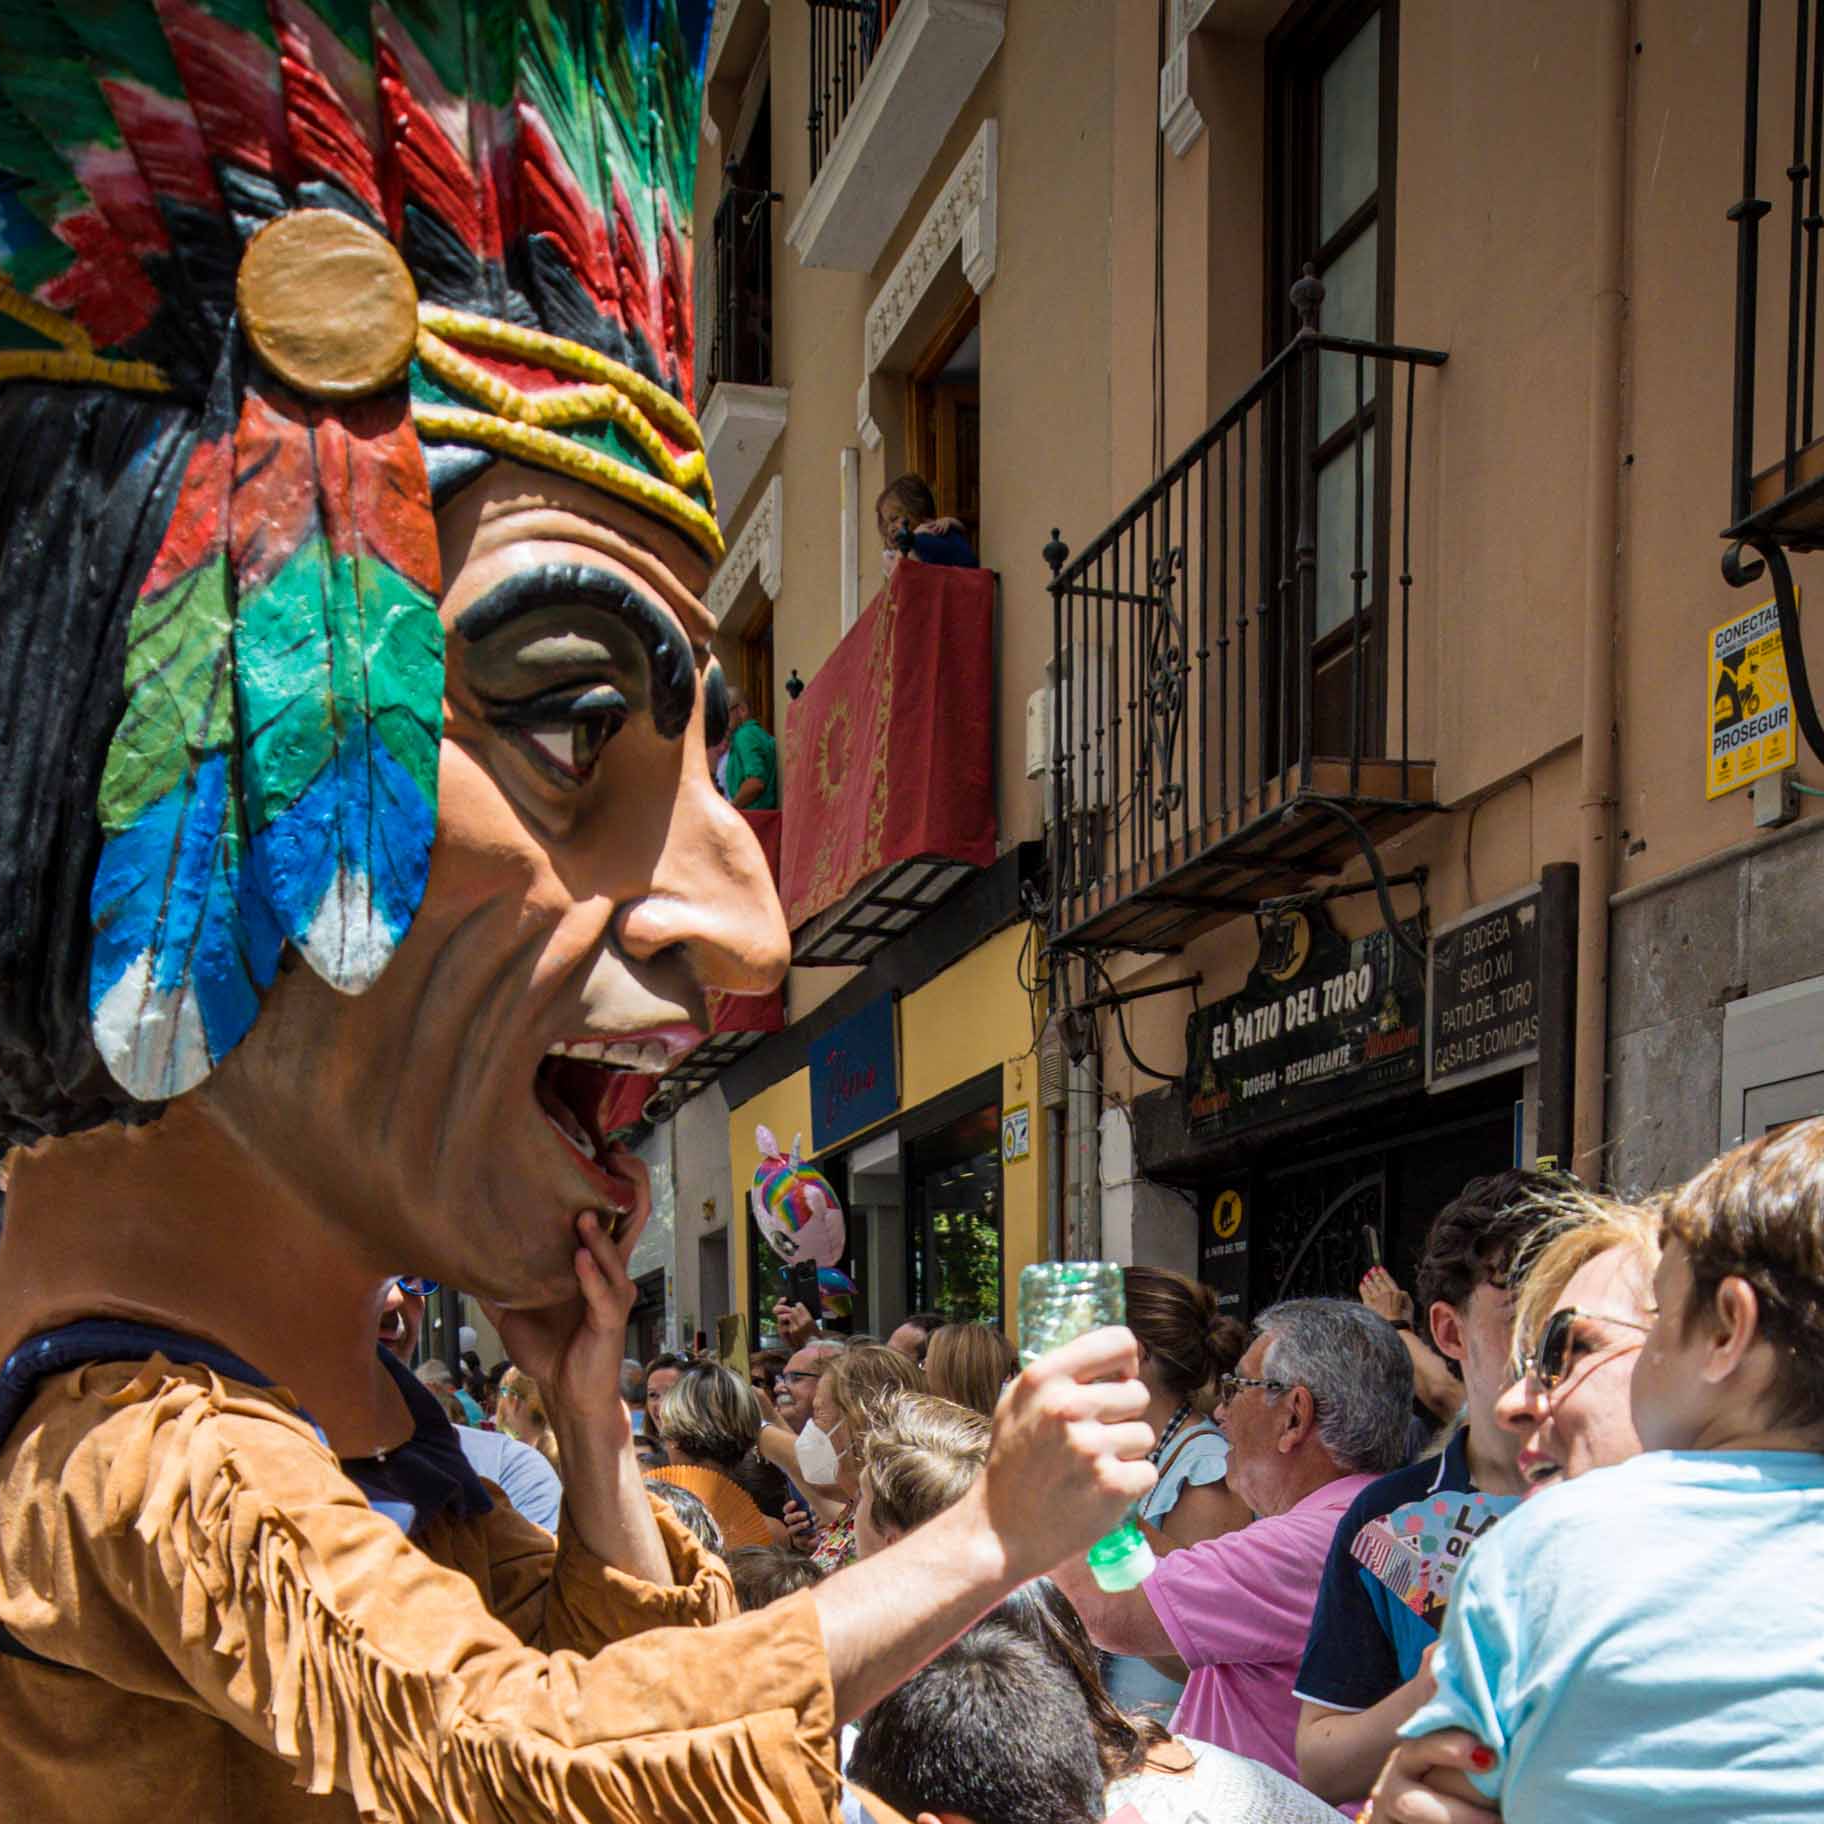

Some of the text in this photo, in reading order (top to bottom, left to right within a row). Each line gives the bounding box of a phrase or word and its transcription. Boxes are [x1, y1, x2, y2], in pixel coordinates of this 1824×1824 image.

[1715, 604, 1781, 648] CONECTAD
[1713, 706, 1789, 755] PROSEGUR
[1463, 915, 1511, 955] BODEGA
[1460, 952, 1513, 993] SIGLO XVI
[1212, 963, 1371, 1060] EL PATIO DEL TORO
[1441, 980, 1533, 1033] PATIO DEL TORO
[1435, 1039, 1464, 1072] CASA
[1466, 1033, 1482, 1061] DE
[1483, 1016, 1539, 1056] COMIDAS
[1242, 1071, 1277, 1099] BODEGA
[1284, 1044, 1351, 1085] RESTAURANTE
